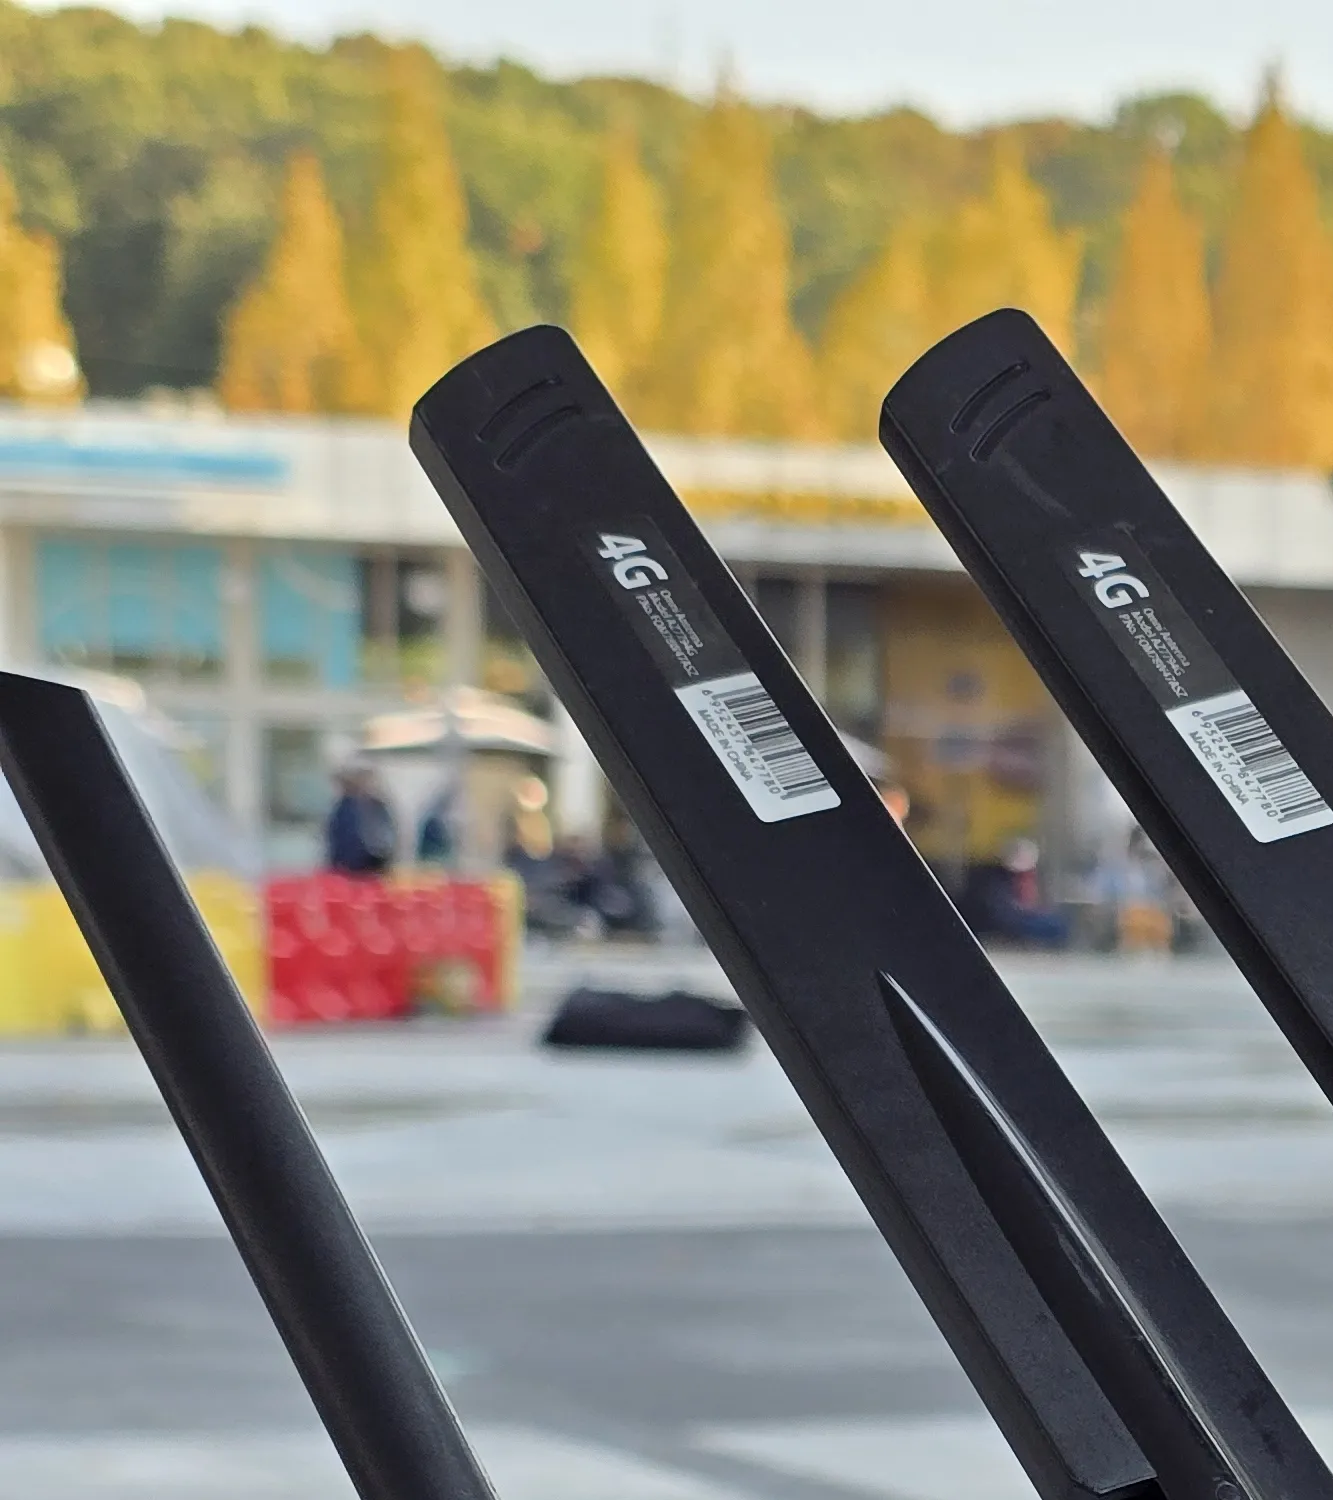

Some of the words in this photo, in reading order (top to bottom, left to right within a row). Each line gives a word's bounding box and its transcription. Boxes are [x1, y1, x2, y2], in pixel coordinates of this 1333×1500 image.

[597, 532, 669, 589] 4G
[1078, 552, 1150, 609] 4G
[698, 709, 724, 738] MADE
[1189, 730, 1217, 761] MADE
[1211, 761, 1226, 773] IN
[1221, 774, 1249, 806] CHINA
